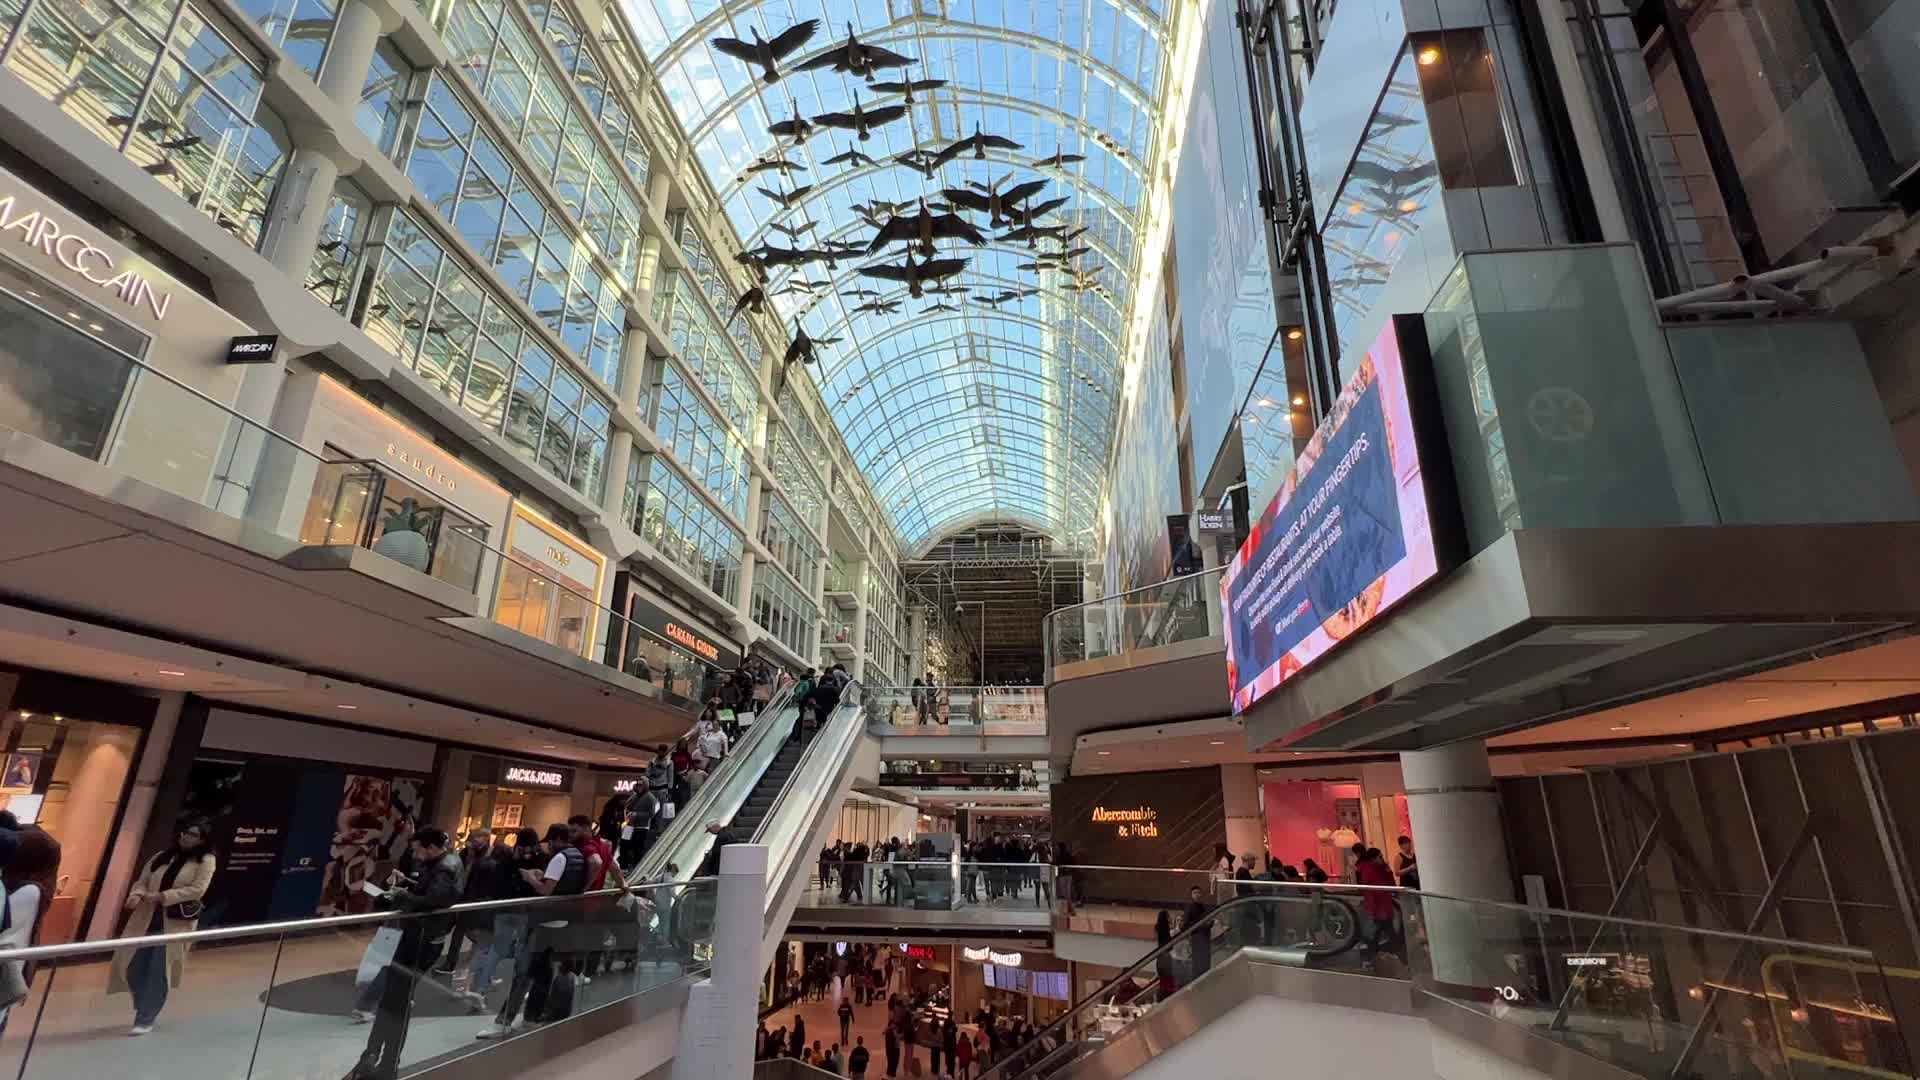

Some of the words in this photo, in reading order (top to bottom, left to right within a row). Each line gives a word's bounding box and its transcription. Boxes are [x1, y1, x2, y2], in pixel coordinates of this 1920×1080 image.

[387, 443, 457, 491] sandro
[1300, 507, 1308, 530] AT
[1306, 485, 1326, 519] YOUR
[1325, 431, 1370, 498] FINGERTIPS.
[506, 767, 562, 786] JACK&JONES
[1092, 805, 1157, 821] Abercrombie
[1118, 825, 1128, 837] &
[1131, 821, 1158, 837] Fitch
[989, 951, 1021, 966] SQUEEZED
